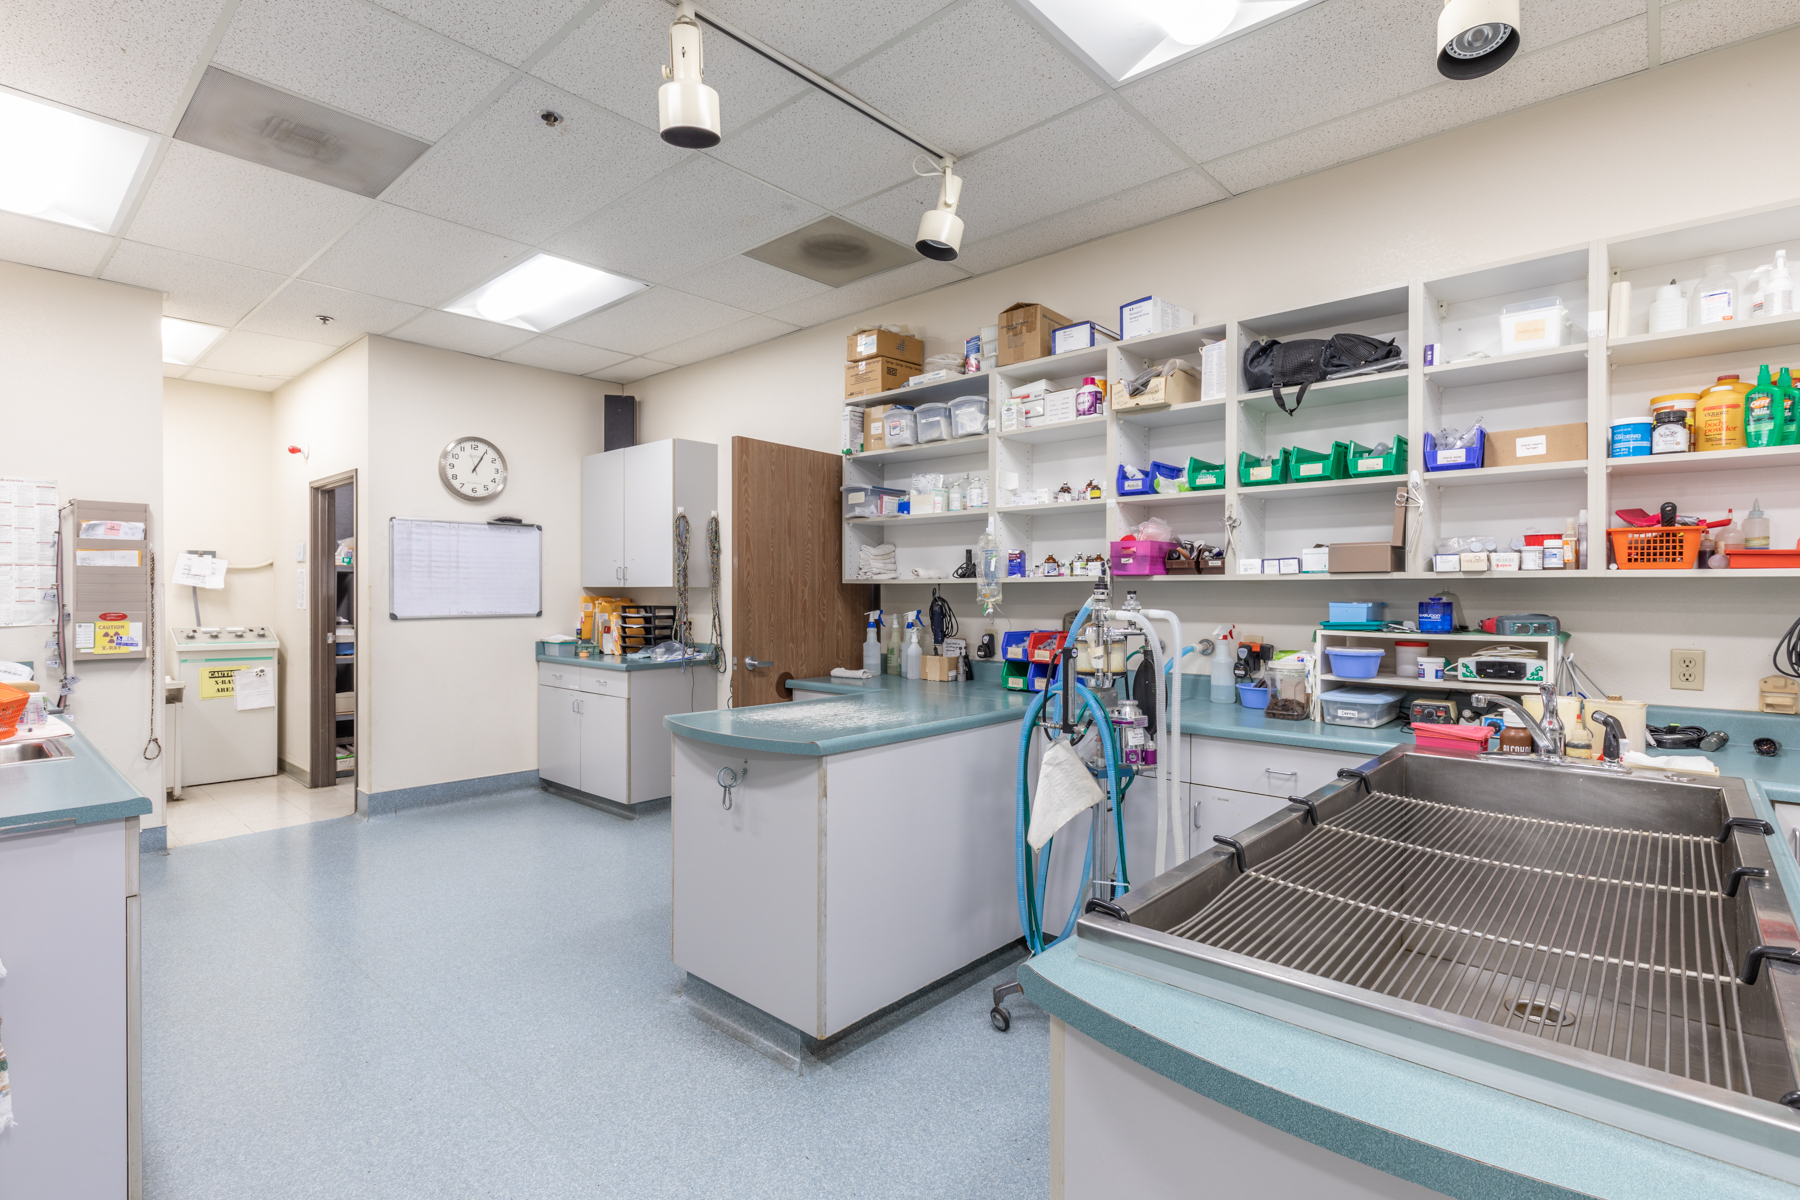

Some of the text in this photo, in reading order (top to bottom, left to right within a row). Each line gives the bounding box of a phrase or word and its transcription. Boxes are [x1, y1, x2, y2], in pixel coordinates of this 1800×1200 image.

[1750, 397, 1771, 408] OFF!
[1705, 420, 1727, 429] body
[1704, 425, 1738, 436] powder
[209, 670, 235, 678] CAUTIO
